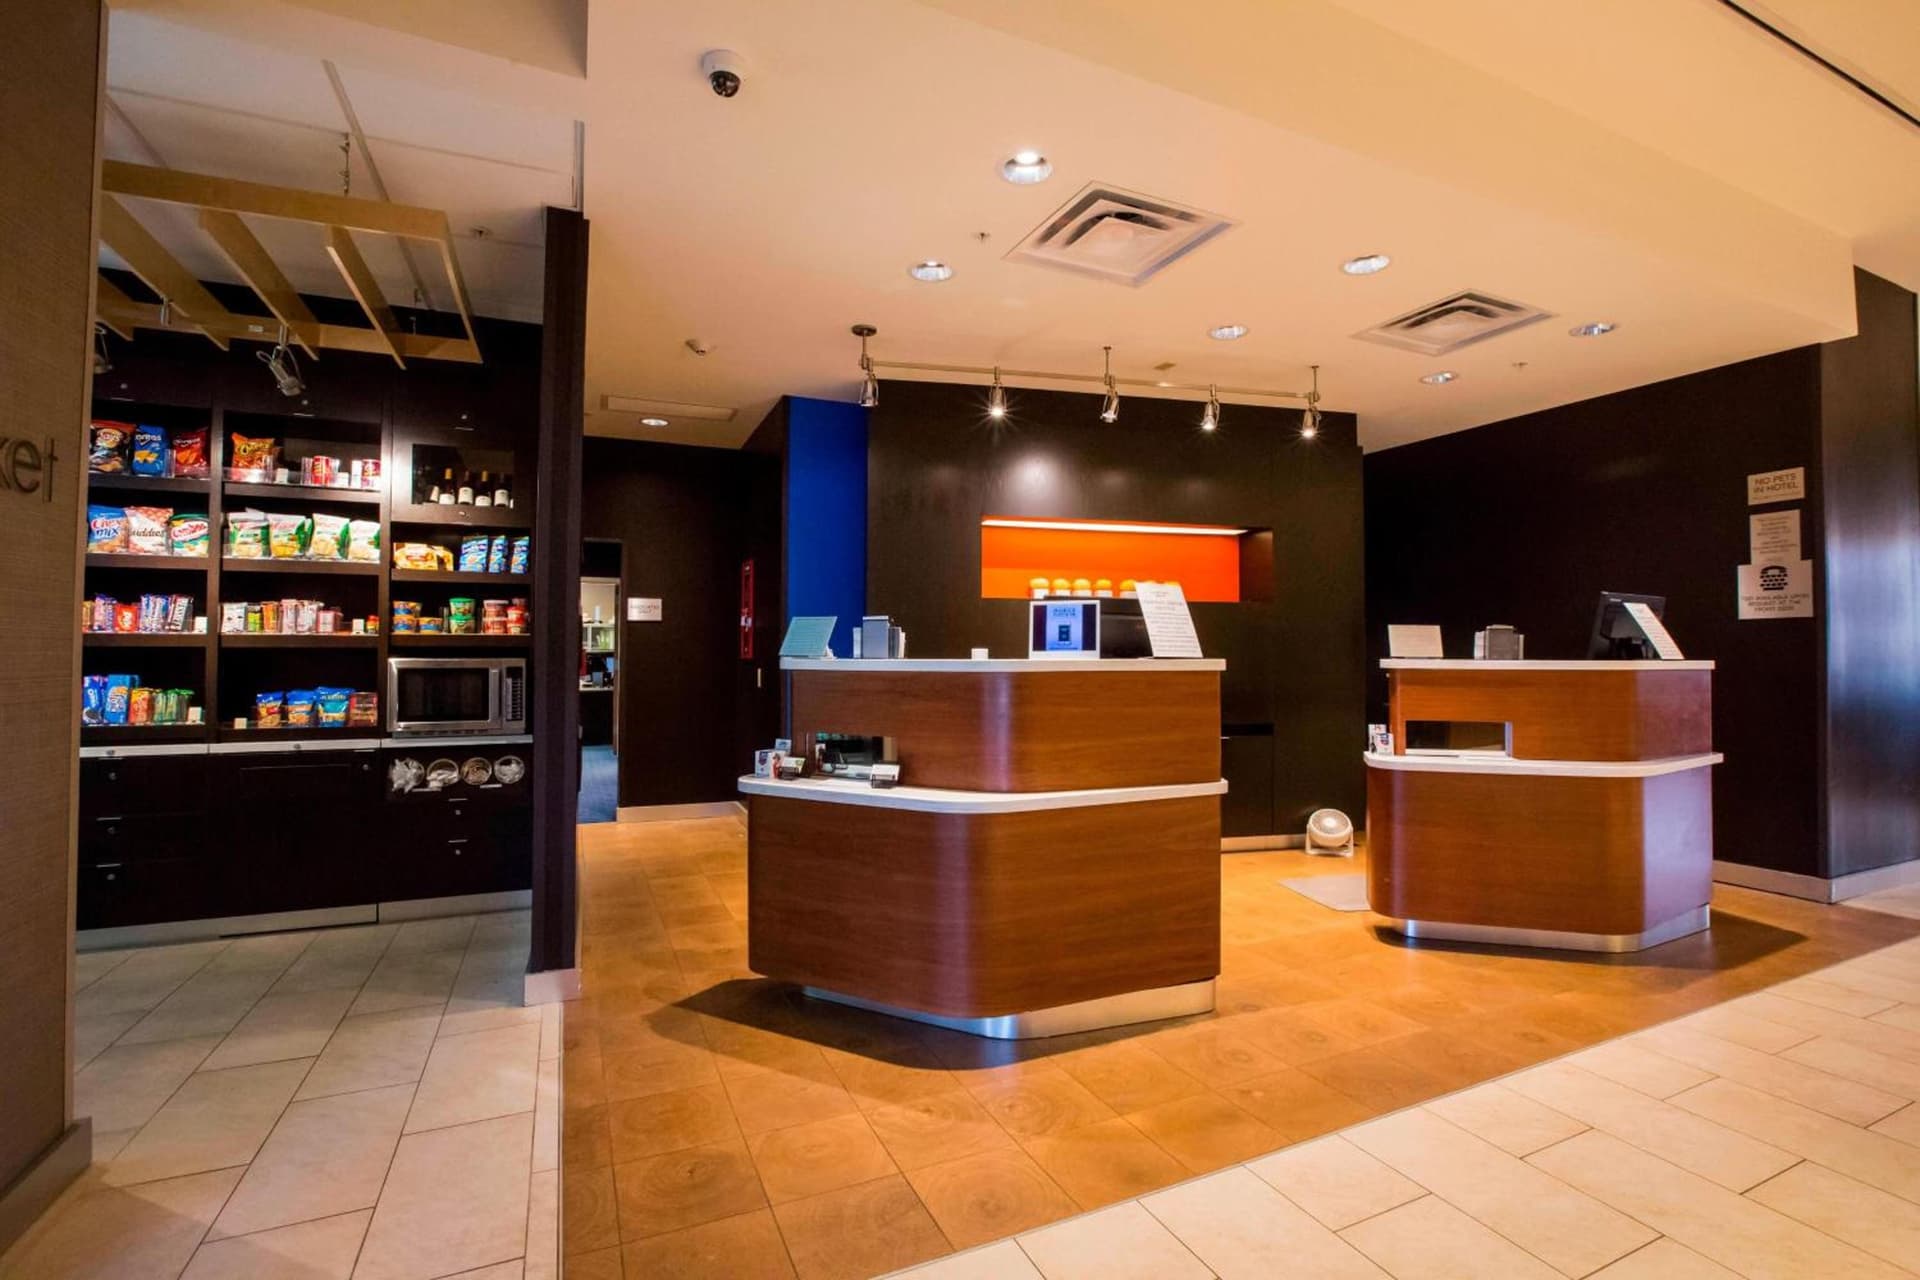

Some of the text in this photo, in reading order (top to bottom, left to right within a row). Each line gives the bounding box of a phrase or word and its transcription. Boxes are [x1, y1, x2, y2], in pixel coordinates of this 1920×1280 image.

[1755, 472, 1797, 485] NO PETS
[1766, 481, 1799, 491] HOTEL
